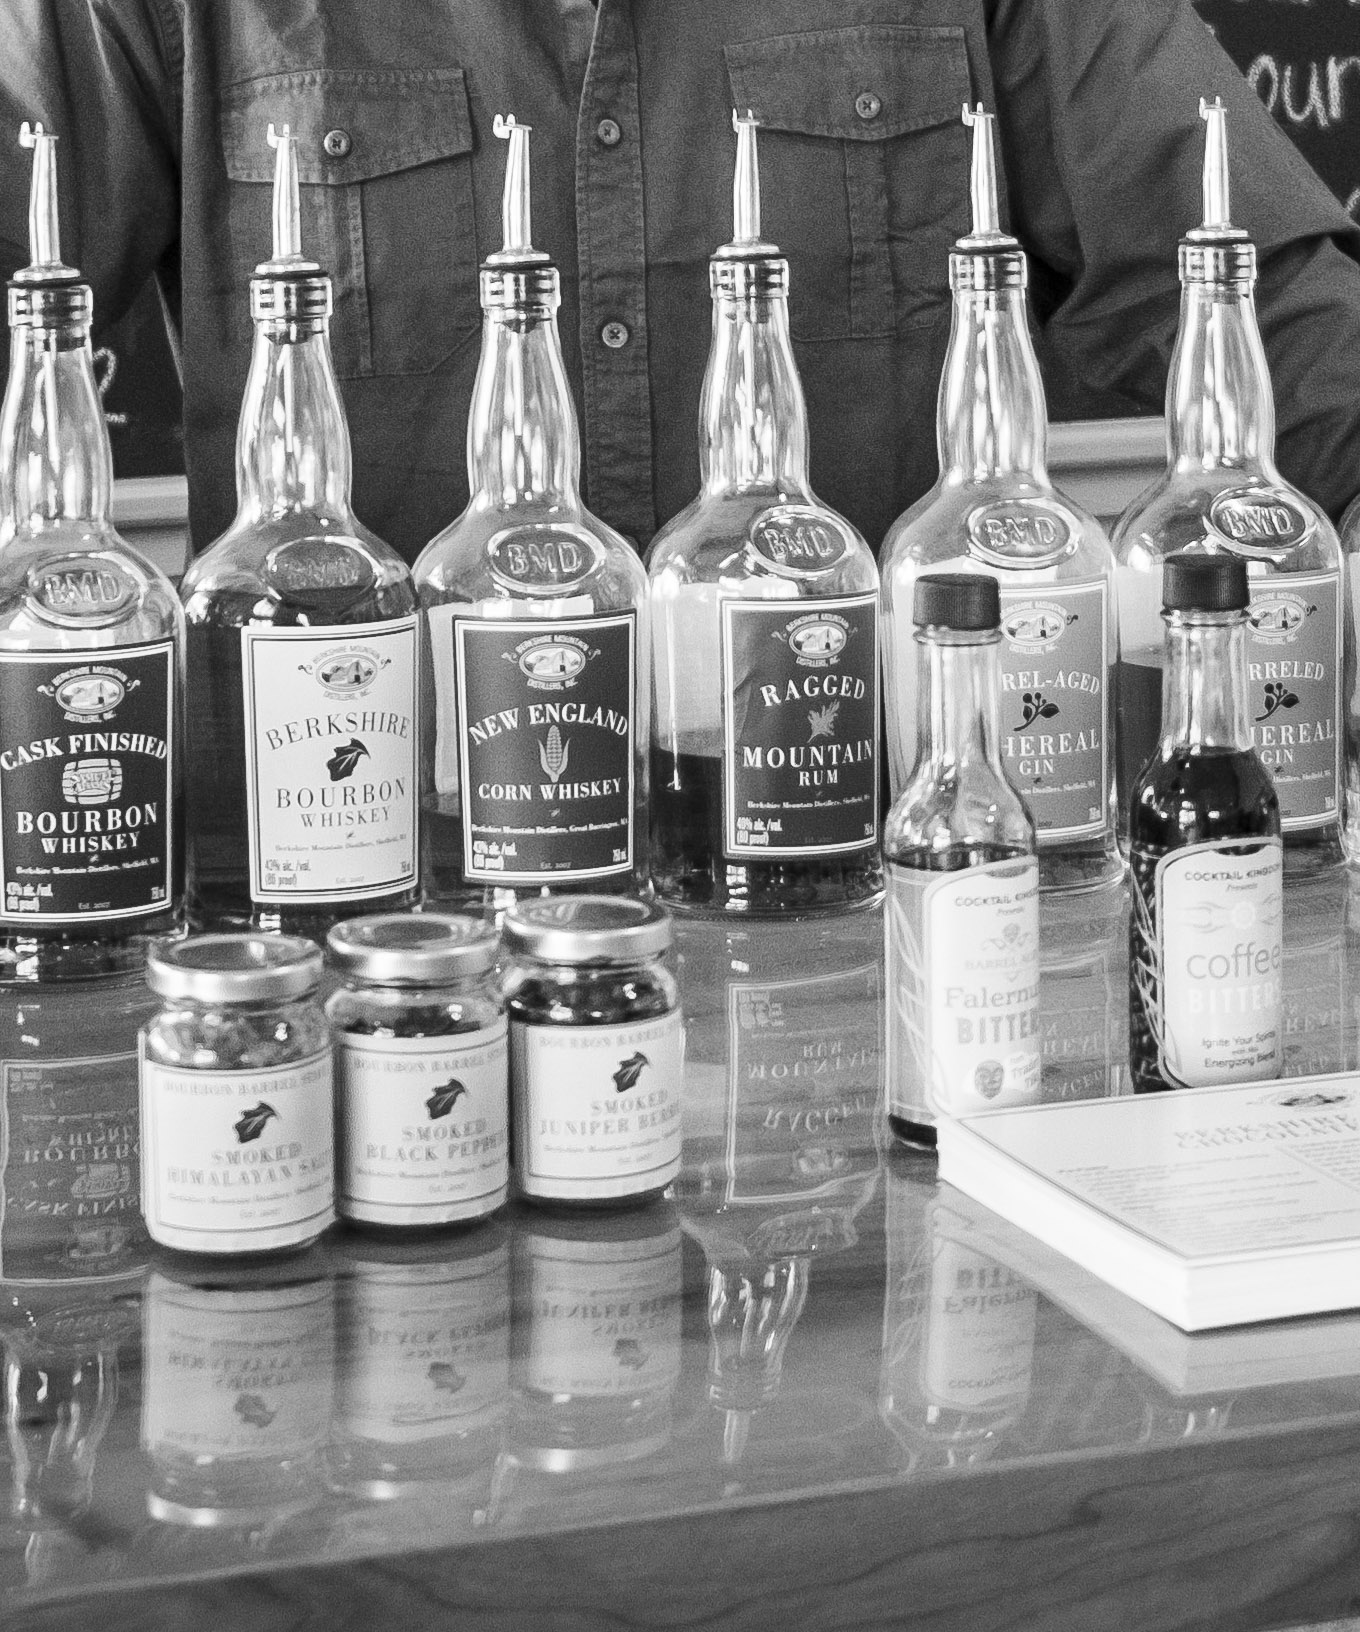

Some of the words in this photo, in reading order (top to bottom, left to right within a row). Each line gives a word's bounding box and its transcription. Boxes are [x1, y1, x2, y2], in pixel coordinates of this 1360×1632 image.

[763, 524, 834, 561] BMD
[984, 515, 1057, 550] BMD
[507, 541, 583, 575] BMD
[43, 569, 124, 607] BMD
[1001, 669, 1100, 696] REL-AGED
[1248, 660, 1325, 681] RRELED
[759, 675, 865, 707] RAGGED
[265, 710, 410, 752] BERKSHIRE
[468, 707, 519, 746] NEW
[529, 702, 629, 737] ENGLAND
[0, 736, 63, 771] CASK
[68, 731, 169, 761] FINISHED
[742, 738, 874, 768] MOUNTAIN
[1260, 748, 1295, 765] GIN
[799, 768, 839, 787] RUM
[1019, 758, 1055, 776] GIN
[276, 776, 407, 810] BOURBON
[478, 780, 533, 800] CORN
[540, 777, 623, 800] WHISKEY
[16, 802, 158, 835] BOURBON
[300, 806, 392, 829] WHISKEY
[41, 831, 141, 854] WHISKEY
[1185, 870, 1243, 881] COCKTAIL
[955, 895, 1012, 907] COCKTAIL
[591, 1089, 669, 1116] SMOKED
[401, 1119, 488, 1142] SMOKED
[540, 1119, 629, 1136] JUNIPER
[211, 1142, 302, 1166] SMOKED
[366, 1143, 438, 1162] BLACK
